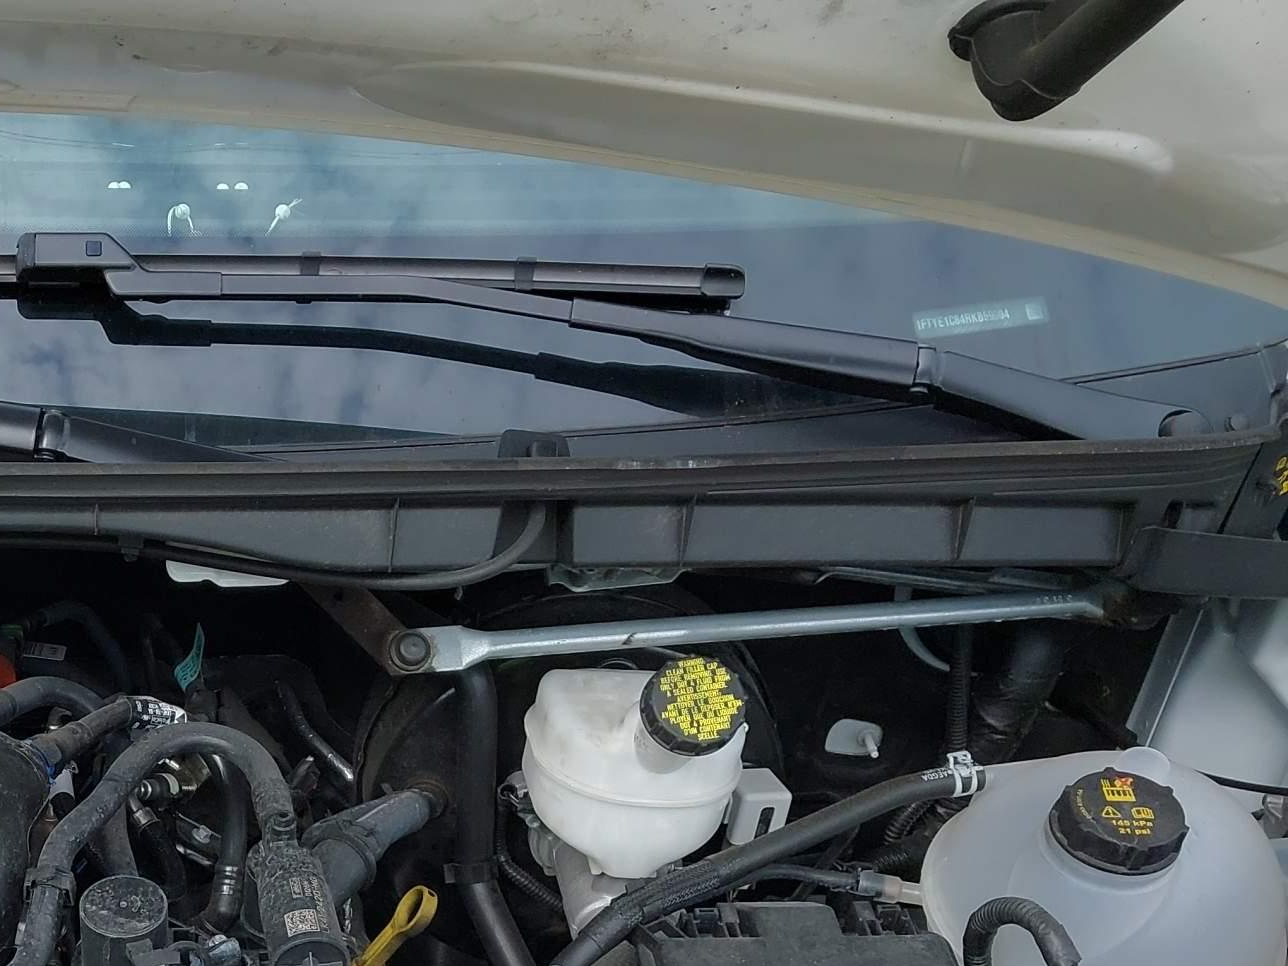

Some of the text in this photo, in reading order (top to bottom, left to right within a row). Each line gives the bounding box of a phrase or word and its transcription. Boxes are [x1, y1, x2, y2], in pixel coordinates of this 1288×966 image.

[660, 675, 682, 684] BEFORE
[715, 667, 727, 675] USE
[666, 668, 684, 676] CLEAN
[686, 664, 705, 673] FILLER
[660, 682, 675, 691] ONLY
[677, 680, 688, 688] DOT
[697, 676, 713, 685] FLUID
[714, 673, 731, 682] FROM
[673, 687, 694, 696] SEALED
[667, 700, 695, 710] NETTOYER
[708, 694, 735, 703] BOUCHON
[661, 709, 679, 718] AVANT
[669, 714, 692, 724] PLOYER
[693, 712, 706, 720] QUE
[717, 706, 739, 716] LIQUIDE
[680, 721, 691, 730] DOT
[699, 715, 732, 726] PROVENANT
[699, 721, 731, 732] CONTENANT
[1132, 819, 1153, 827] kPa
[1134, 828, 1151, 836] psi
